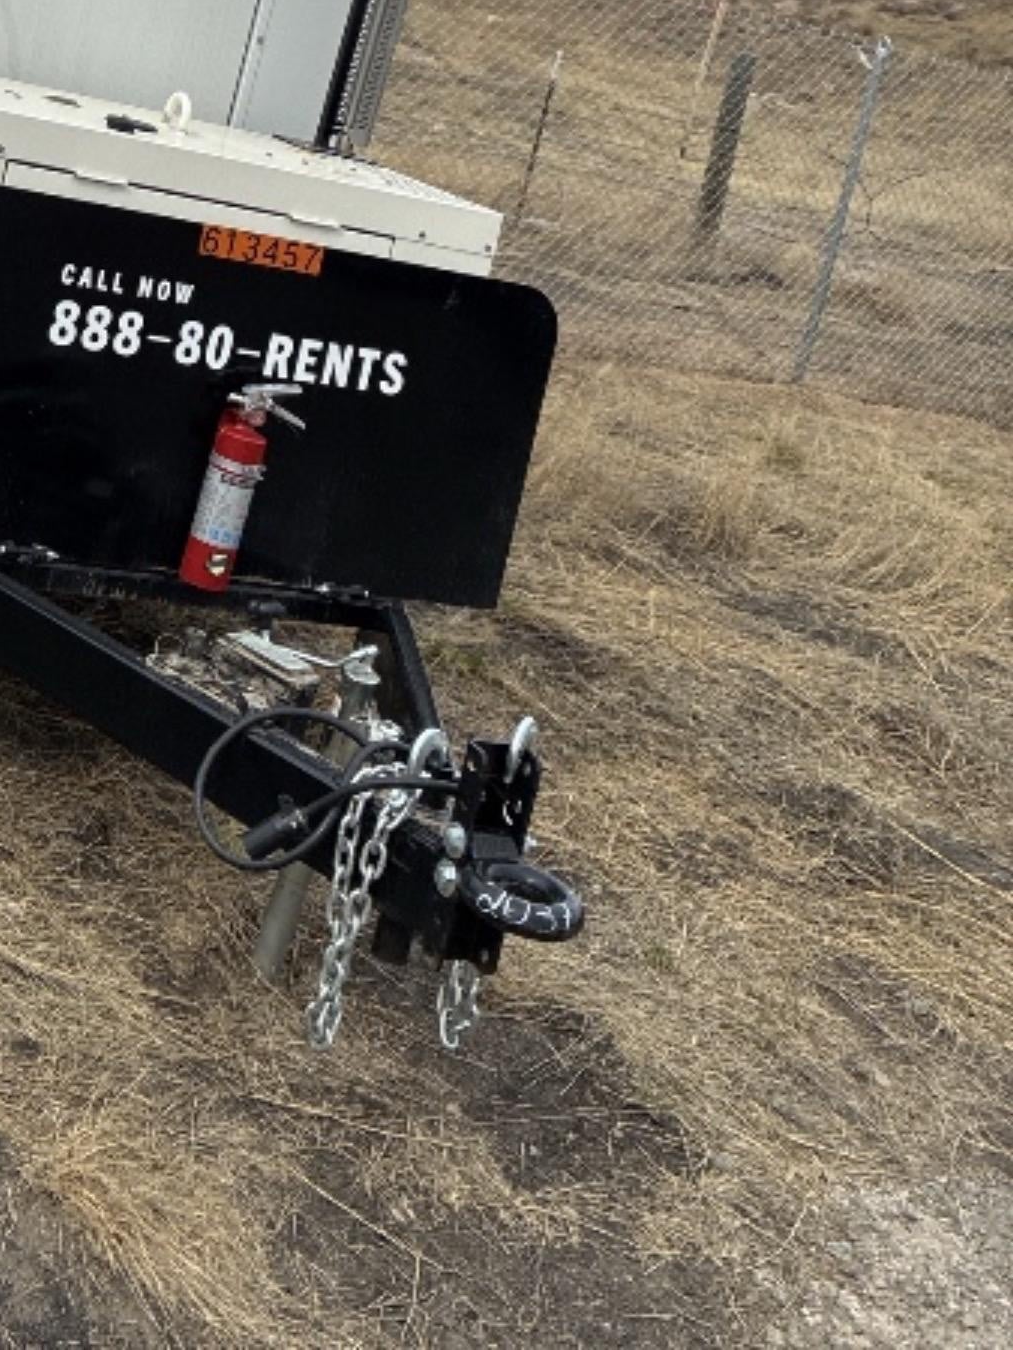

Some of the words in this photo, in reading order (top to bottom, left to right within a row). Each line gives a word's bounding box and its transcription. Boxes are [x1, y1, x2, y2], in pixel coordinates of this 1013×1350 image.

[202, 227, 321, 271] 613457
[60, 263, 124, 295] CALL
[137, 275, 195, 304] NOW
[48, 300, 409, 396] 888-80-RENTS
